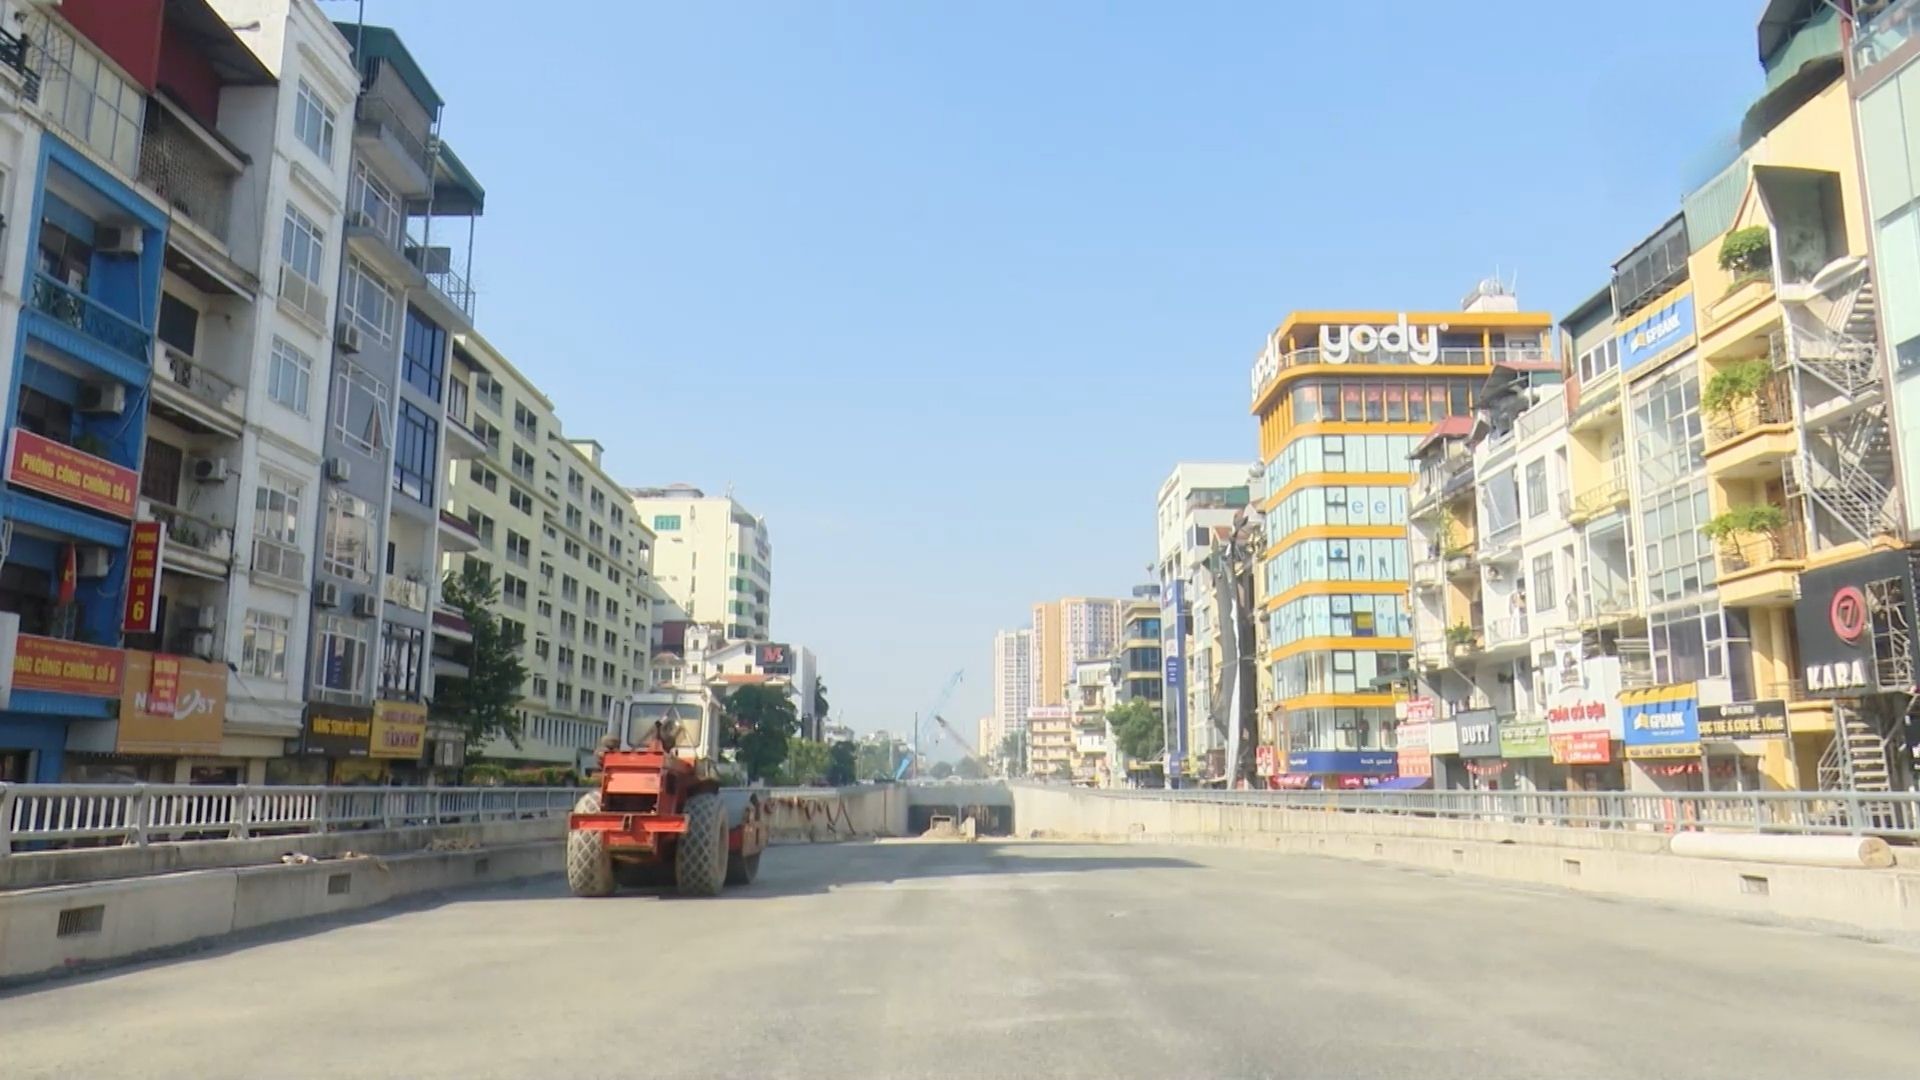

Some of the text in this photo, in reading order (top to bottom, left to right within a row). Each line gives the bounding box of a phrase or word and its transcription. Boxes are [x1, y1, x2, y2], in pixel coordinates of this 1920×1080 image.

[1319, 313, 1438, 365] yody
[132, 601, 145, 621] 6
[1806, 659, 1867, 691] KARA
[1461, 725, 1491, 746] DUTY
